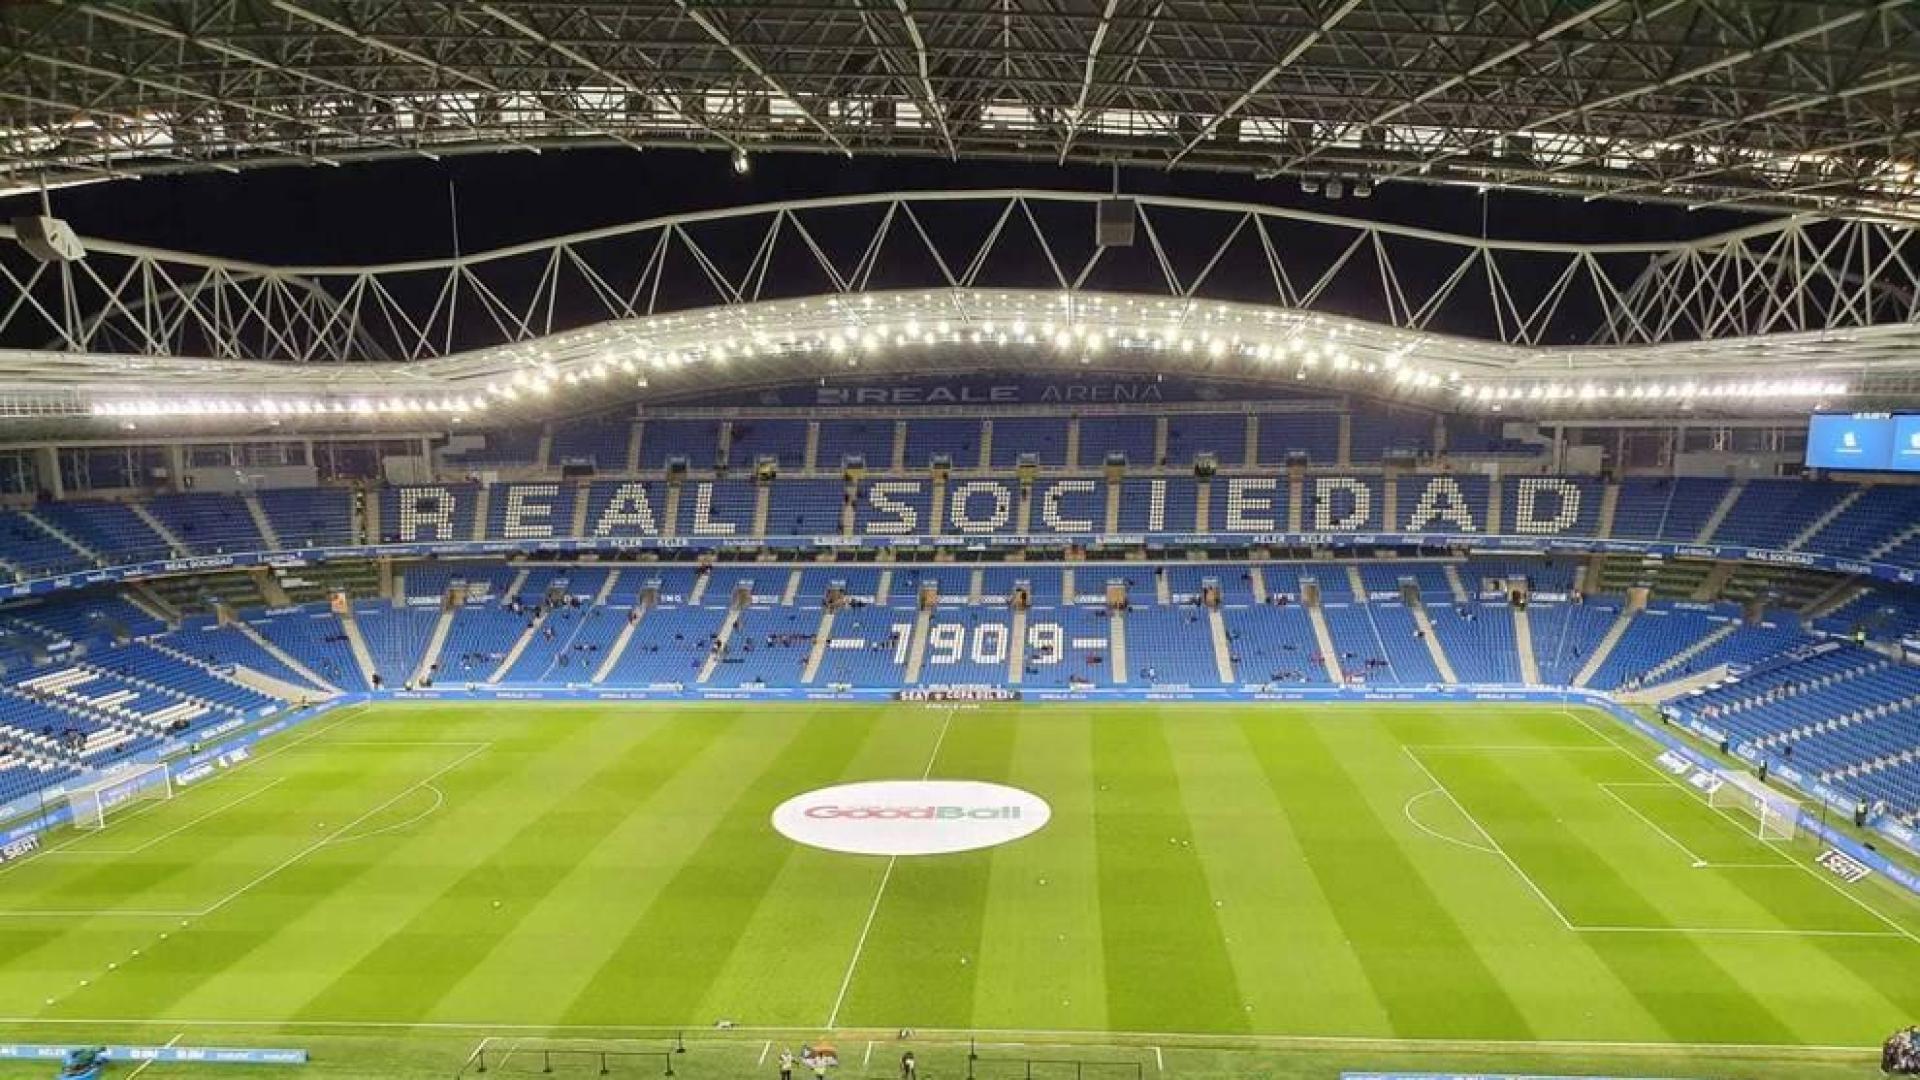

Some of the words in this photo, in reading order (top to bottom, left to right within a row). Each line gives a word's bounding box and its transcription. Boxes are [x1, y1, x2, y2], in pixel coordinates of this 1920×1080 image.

[856, 388, 1019, 402] REALE
[1040, 385, 1163, 402] ARENA
[399, 486, 736, 541] REAL
[866, 479, 1581, 534] SOCIEDAD
[804, 805, 1021, 820] GoodBall
